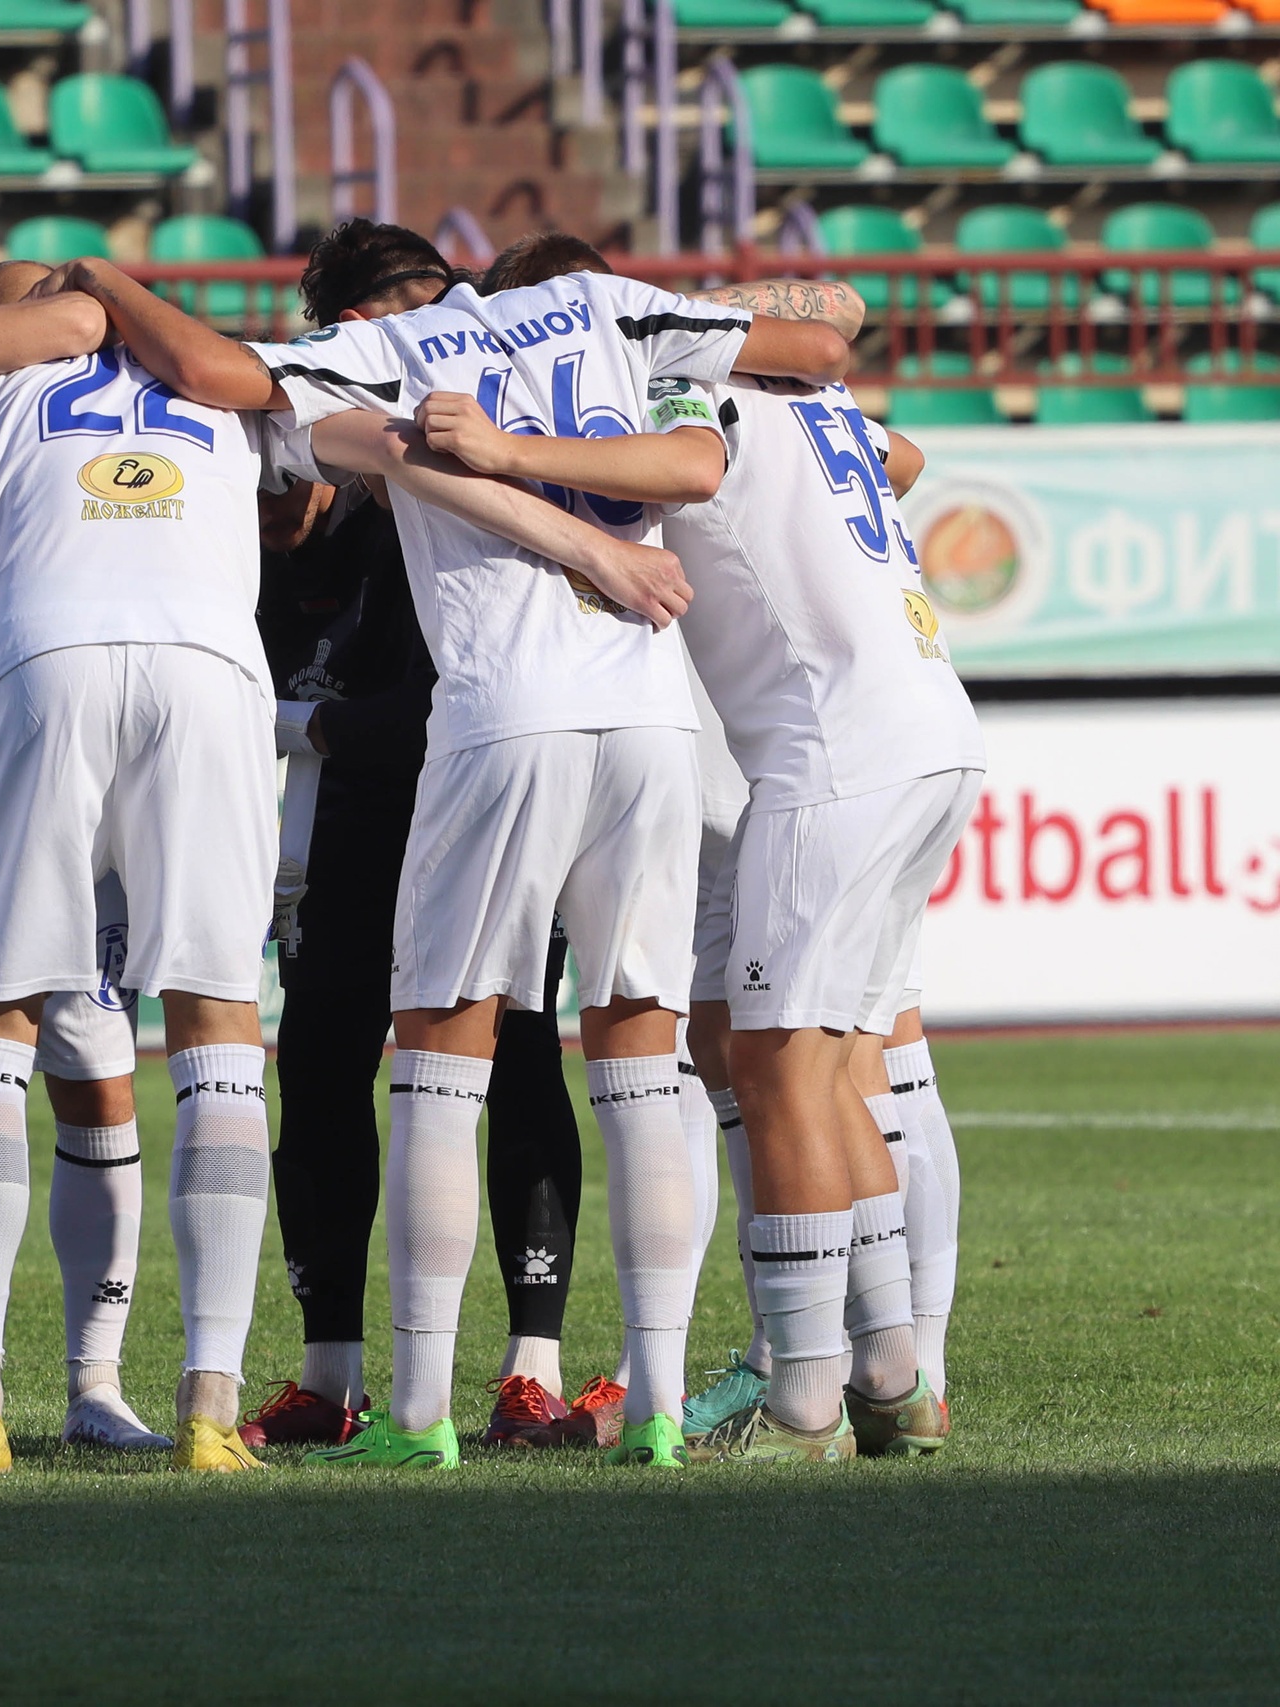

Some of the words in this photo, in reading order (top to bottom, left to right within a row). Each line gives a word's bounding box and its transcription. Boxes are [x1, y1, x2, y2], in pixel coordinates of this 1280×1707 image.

[38, 349, 214, 454] 22
[742, 983, 771, 992] KELME
[195, 1081, 266, 1101] KELME
[417, 1085, 485, 1104] KELME
[594, 1086, 672, 1106] KELME
[513, 1275, 558, 1285] KELME
